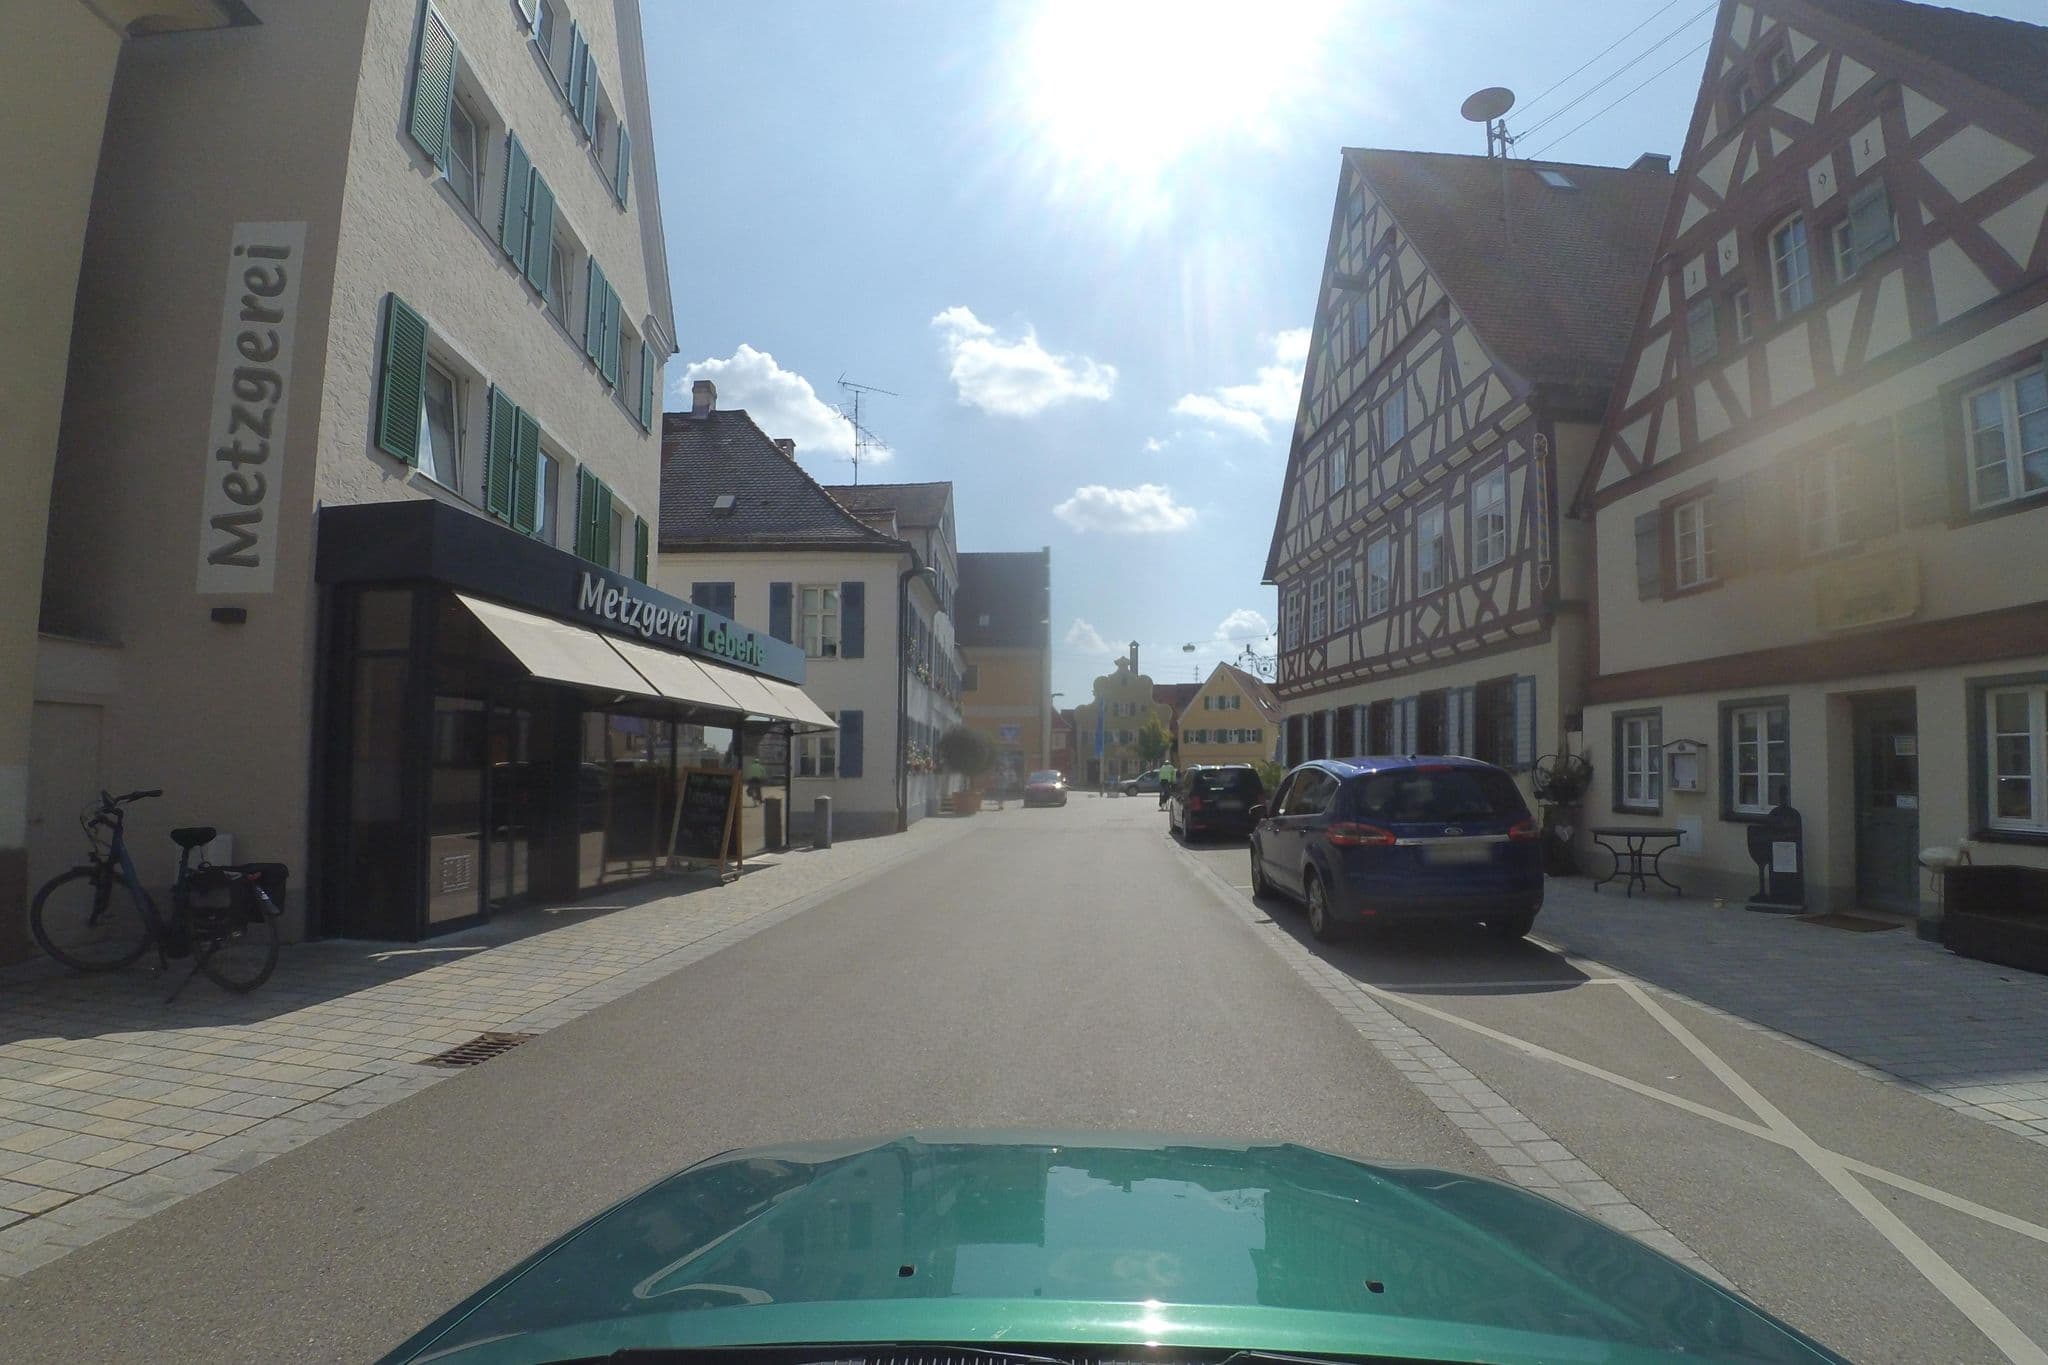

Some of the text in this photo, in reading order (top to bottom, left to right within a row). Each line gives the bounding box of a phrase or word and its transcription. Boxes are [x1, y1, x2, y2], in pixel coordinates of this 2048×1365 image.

[207, 244, 291, 568] Metzgerei
[577, 571, 769, 667] Metzgerei Leberle
